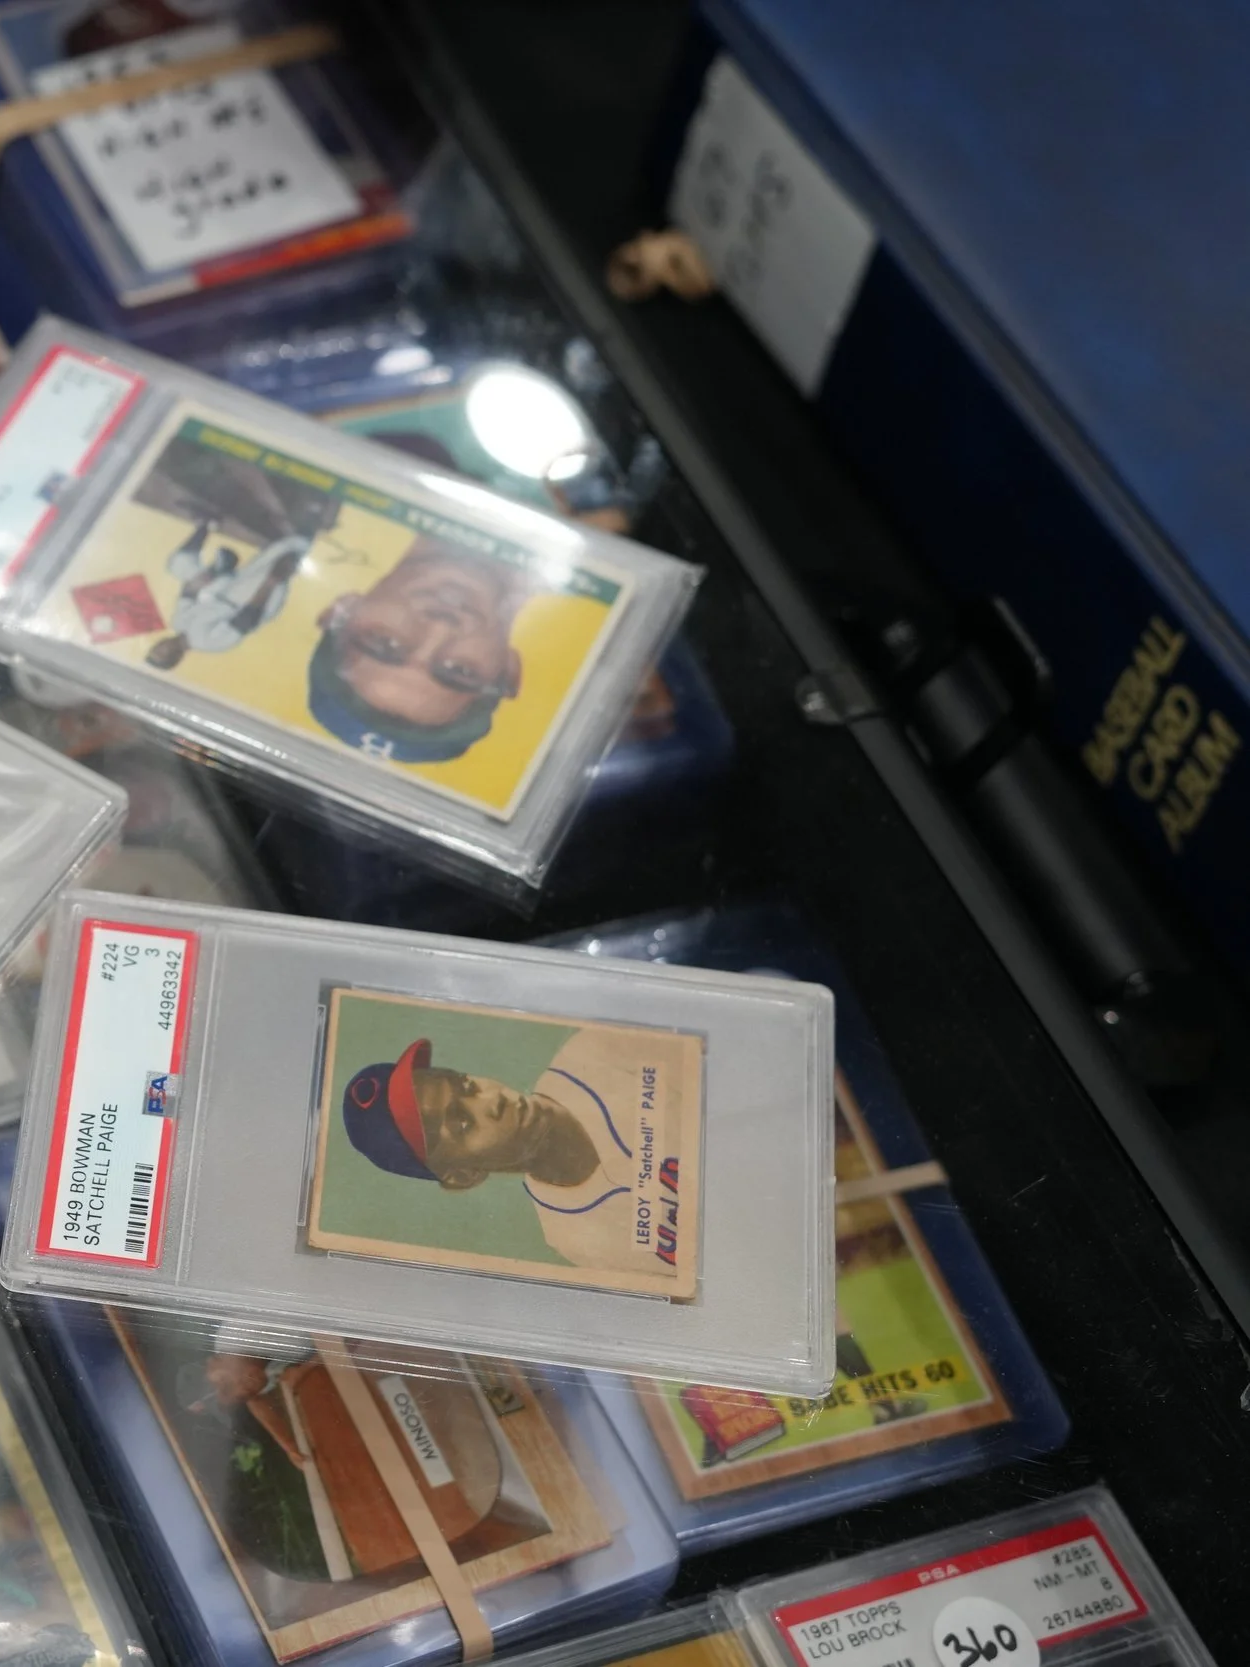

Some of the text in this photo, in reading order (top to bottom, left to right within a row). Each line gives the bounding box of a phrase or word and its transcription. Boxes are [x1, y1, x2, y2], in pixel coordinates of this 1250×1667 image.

[1127, 684, 1200, 800] CARD
[1159, 710, 1242, 855] ALBUM
[101, 943, 120, 982] #224
[122, 944, 140, 968] VG
[145, 948, 160, 957] 3
[158, 950, 182, 1031] 44963342
[63, 1112, 96, 1241] 1949 BOWMAN
[84, 1103, 118, 1246] SATCHELL PAIGE
[636, 1067, 657, 1245] LEROY "Satchell" PAIGE
[860, 1369, 918, 1398] HITS
[924, 1360, 956, 1383] 60
[394, 1392, 438, 1461] MINOSO
[918, 1563, 961, 1585] PSA
[1052, 1545, 1093, 1567] #285
[844, 1601, 902, 1629] TOPPS
[808, 1619, 907, 1660] LOU BROCK
